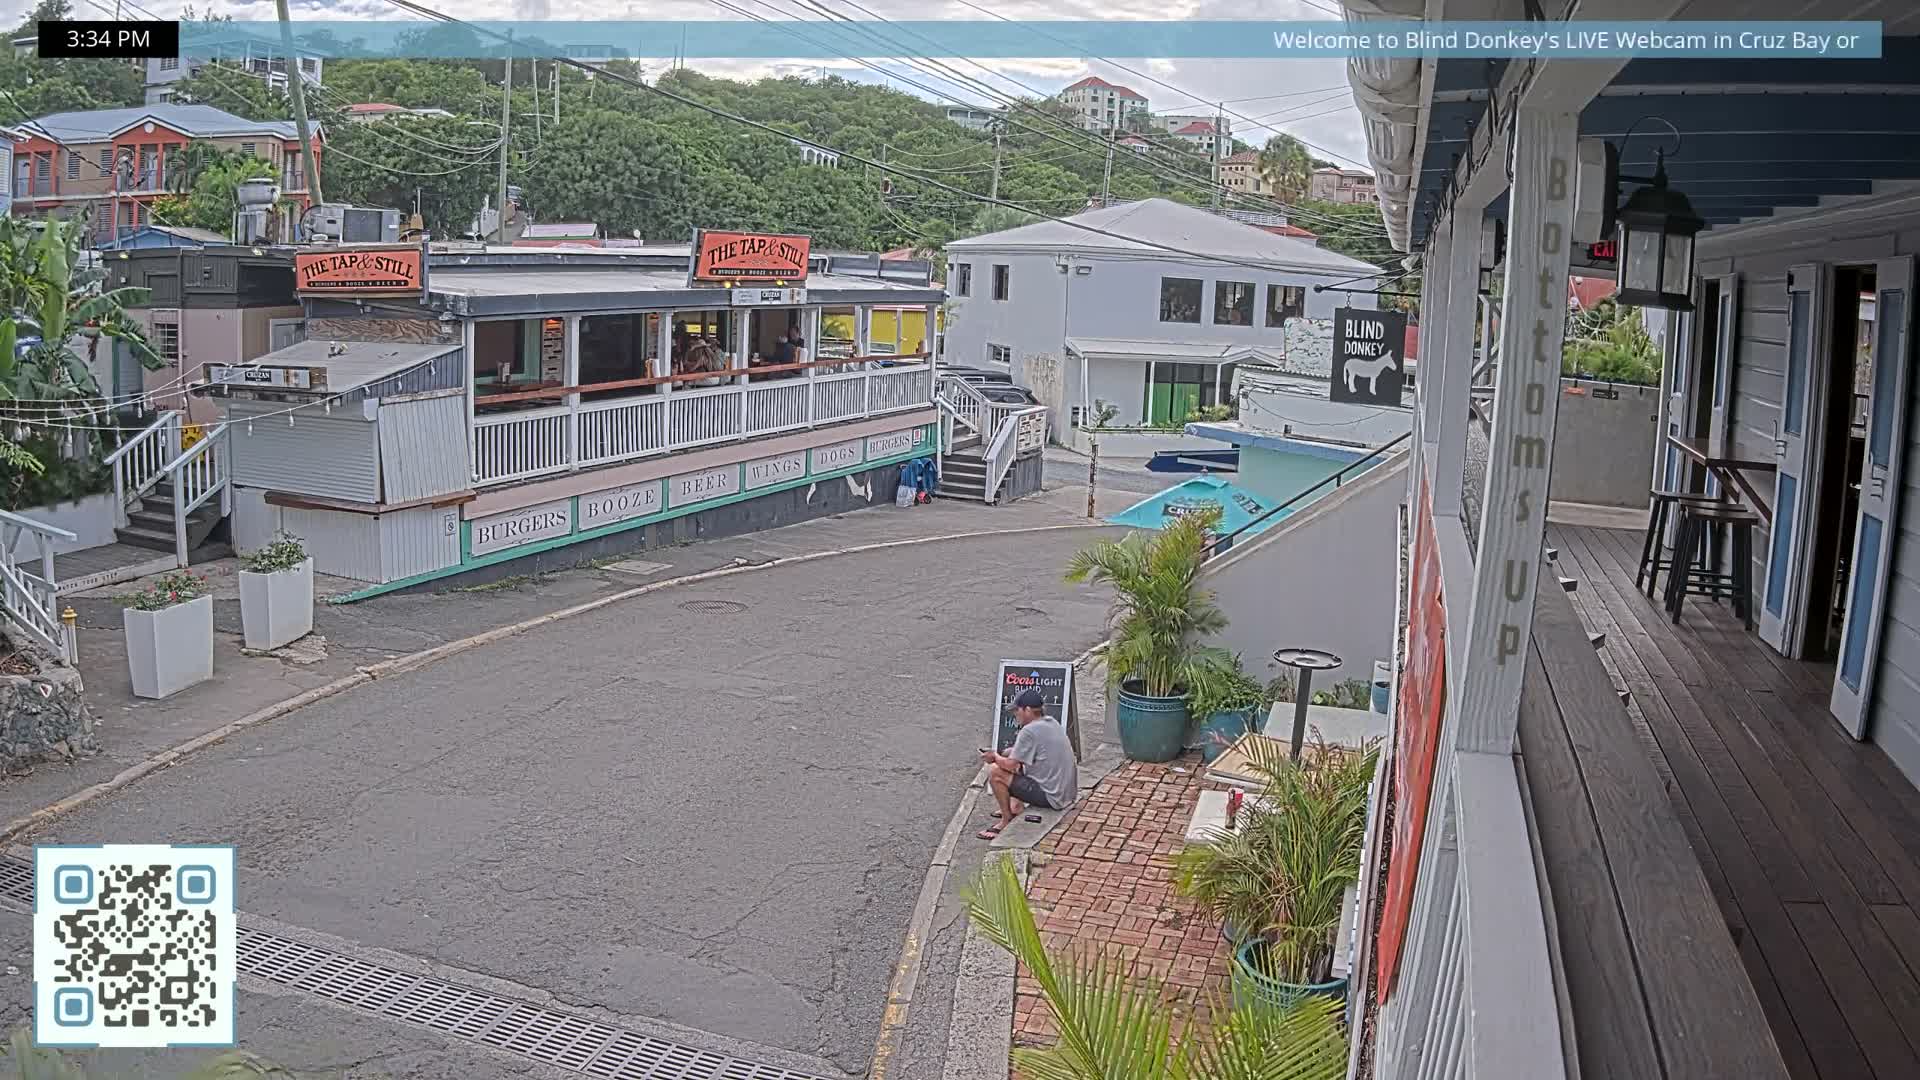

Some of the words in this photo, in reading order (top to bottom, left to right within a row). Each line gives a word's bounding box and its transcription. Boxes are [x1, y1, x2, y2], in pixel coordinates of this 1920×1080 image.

[707, 241, 738, 266] THE
[739, 238, 767, 256] TAP
[763, 238, 780, 257] &
[778, 242, 805, 269] STILL
[1593, 243, 1615, 257] EXI
[302, 259, 330, 280] THE
[329, 255, 358, 271] TAP
[356, 253, 375, 271] &
[374, 256, 414, 280] STILL
[1345, 319, 1385, 340] BLIND
[1513, 158, 1568, 522] Bottoms
[1344, 340, 1385, 356] DONKEY
[246, 371, 271, 379] CRUZAN
[869, 433, 911, 454] BURGERS
[820, 447, 855, 465] DOGS
[752, 458, 801, 480] WINGS
[682, 473, 728, 496] BEER
[588, 489, 655, 518] BOOZE
[478, 511, 567, 545] BURGERS
[1006, 672, 1035, 685] Coors
[1035, 678, 1063, 686] LIGHT
